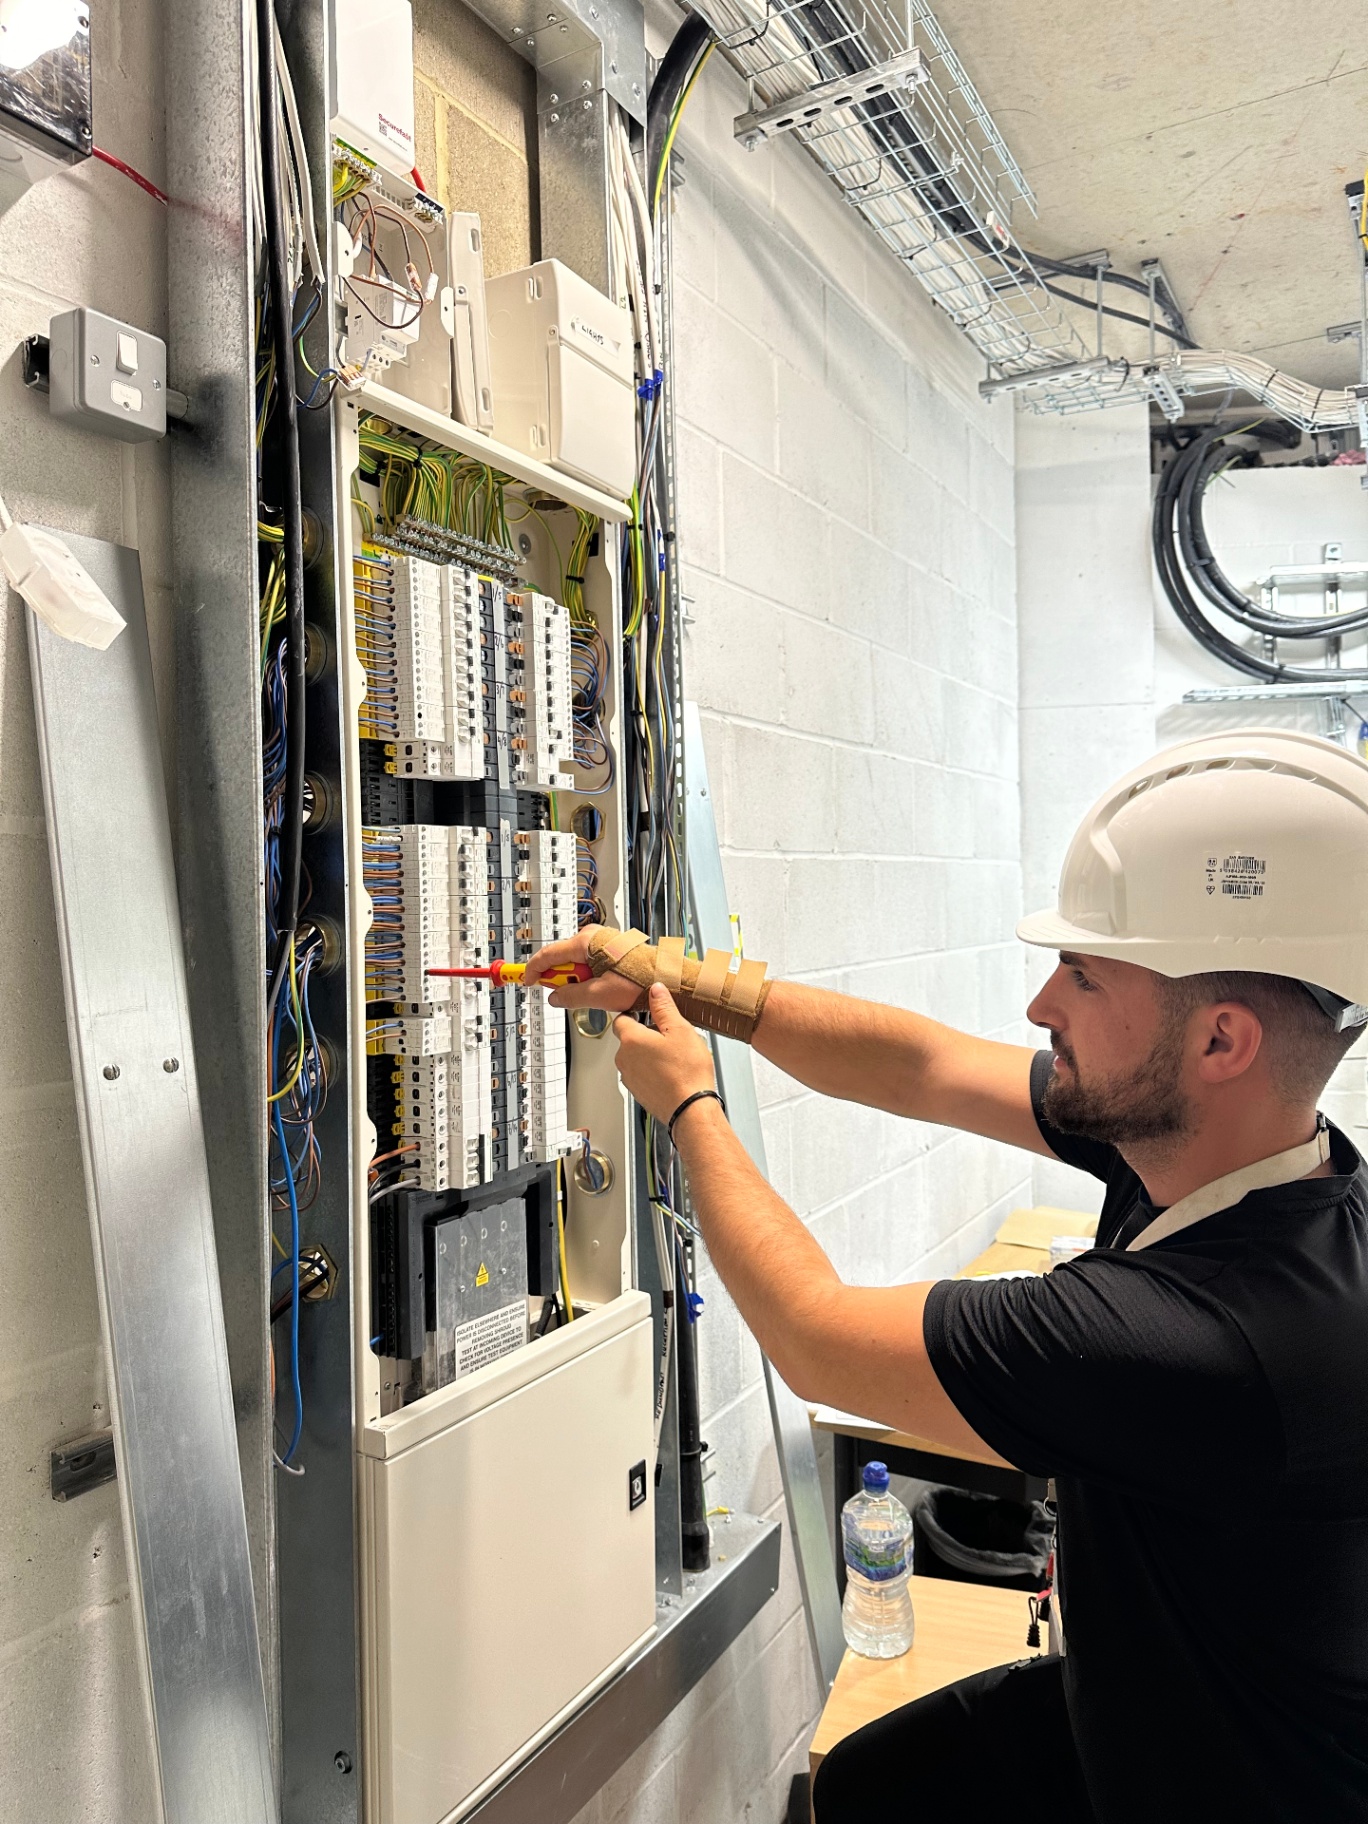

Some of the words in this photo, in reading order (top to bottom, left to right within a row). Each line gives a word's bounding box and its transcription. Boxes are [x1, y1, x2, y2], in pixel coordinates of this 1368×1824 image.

[457, 1325, 474, 1336] ISOLATE
[475, 1314, 499, 1329] ELSEWHERE
[509, 1304, 525, 1314] ENSURE
[457, 1333, 471, 1344] POWER
[478, 1317, 509, 1335] DISCONNECTED
[510, 1311, 526, 1321] BEFORE
[459, 1354, 473, 1364] CHECK
[484, 1342, 502, 1353] VOLTAGE
[503, 1332, 524, 1344] PRESENCE
[462, 1347, 472, 1356] TEST
[479, 1336, 500, 1348] INCOMING
[501, 1329, 515, 1339] DEVICE
[472, 1331, 494, 1344] REMOVING
[460, 1363, 470, 1371] AND
[470, 1355, 487, 1366] ENSURE
[488, 1350, 499, 1358] TEST
[499, 1340, 523, 1354] EQUIPMENT
